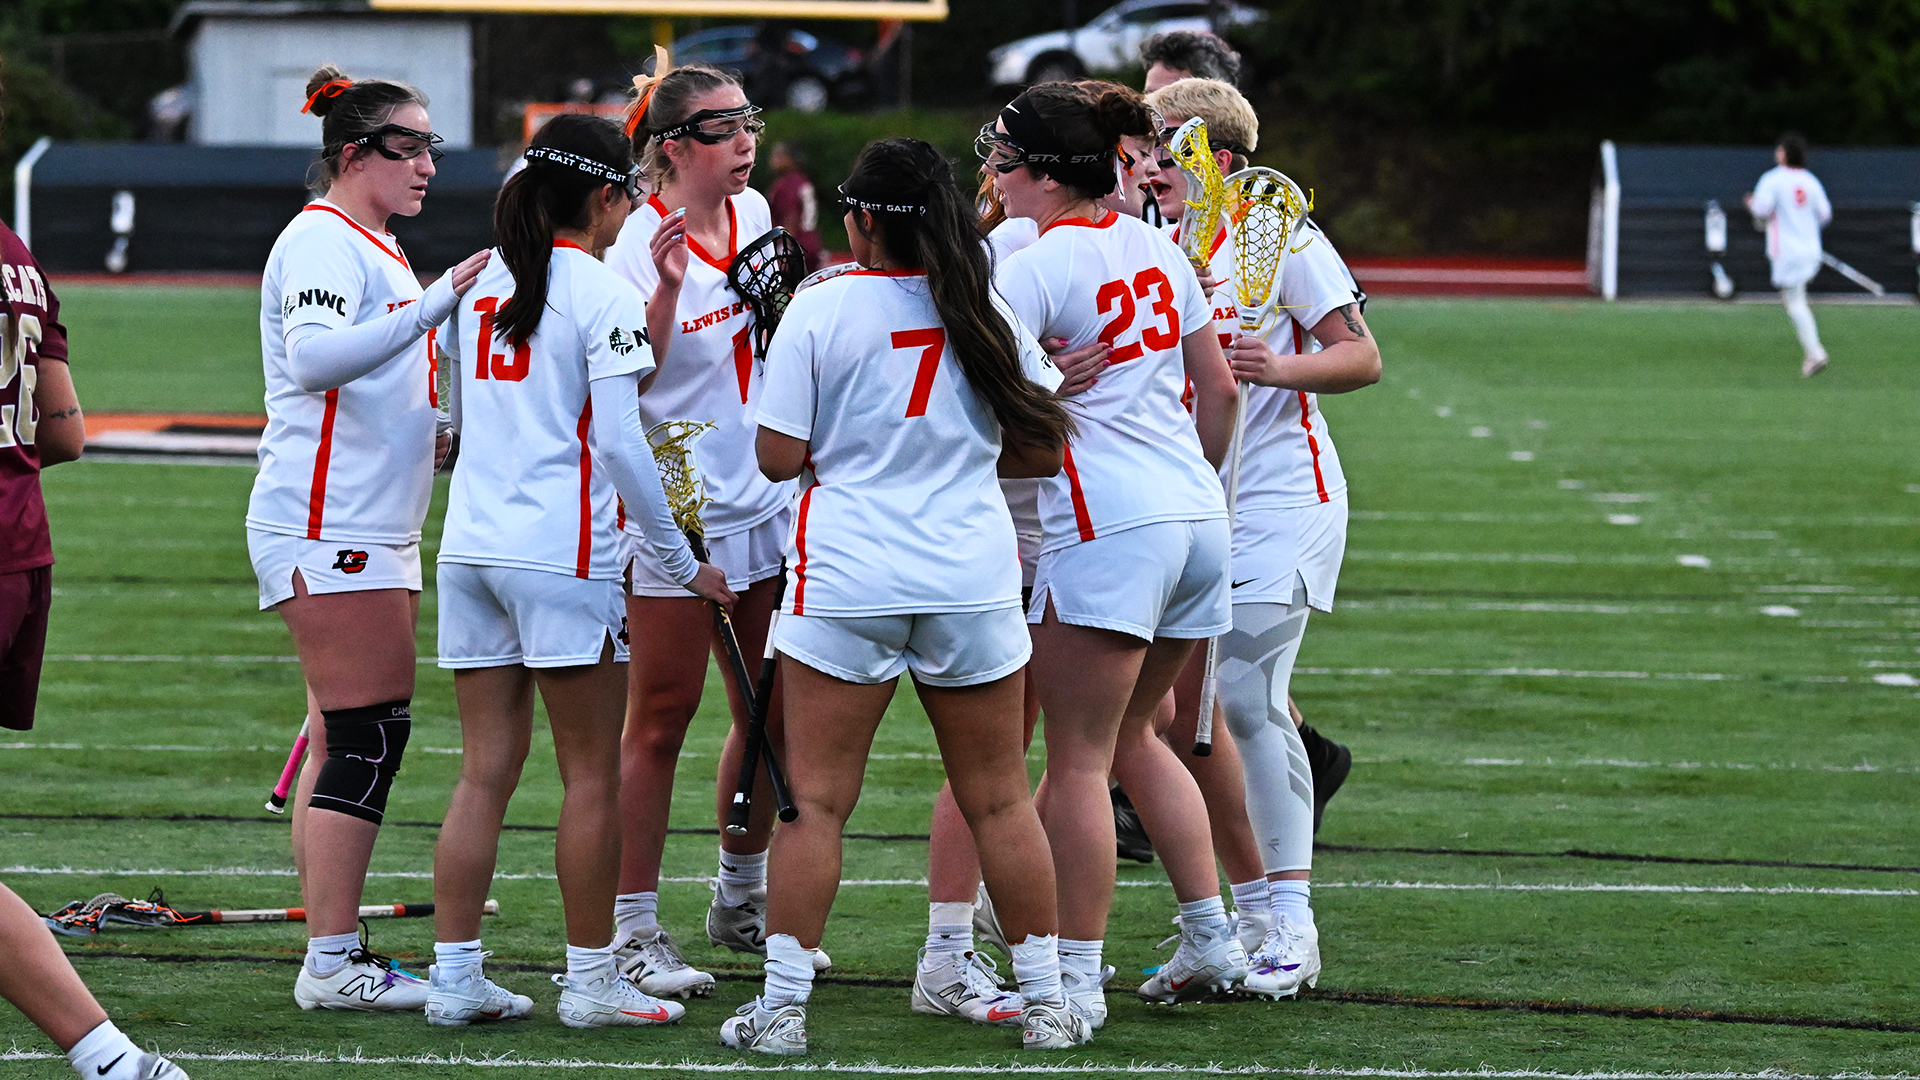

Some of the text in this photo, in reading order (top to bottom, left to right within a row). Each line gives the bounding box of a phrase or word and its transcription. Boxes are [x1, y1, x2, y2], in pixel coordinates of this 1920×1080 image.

[663, 127, 682, 140] GAIT
[526, 149, 626, 182] AIT GAIT GAIT GAIT
[1028, 154, 1060, 163] STX
[1070, 153, 1099, 164] STX
[860, 201, 882, 211] GAIT
[886, 204, 914, 213] GAIT
[0, 264, 48, 313] CATS
[298, 288, 346, 318] NWC
[681, 306, 730, 335] LEWIS
[1095, 266, 1180, 366] 23
[473, 296, 532, 382] 13
[890, 326, 946, 418] 7
